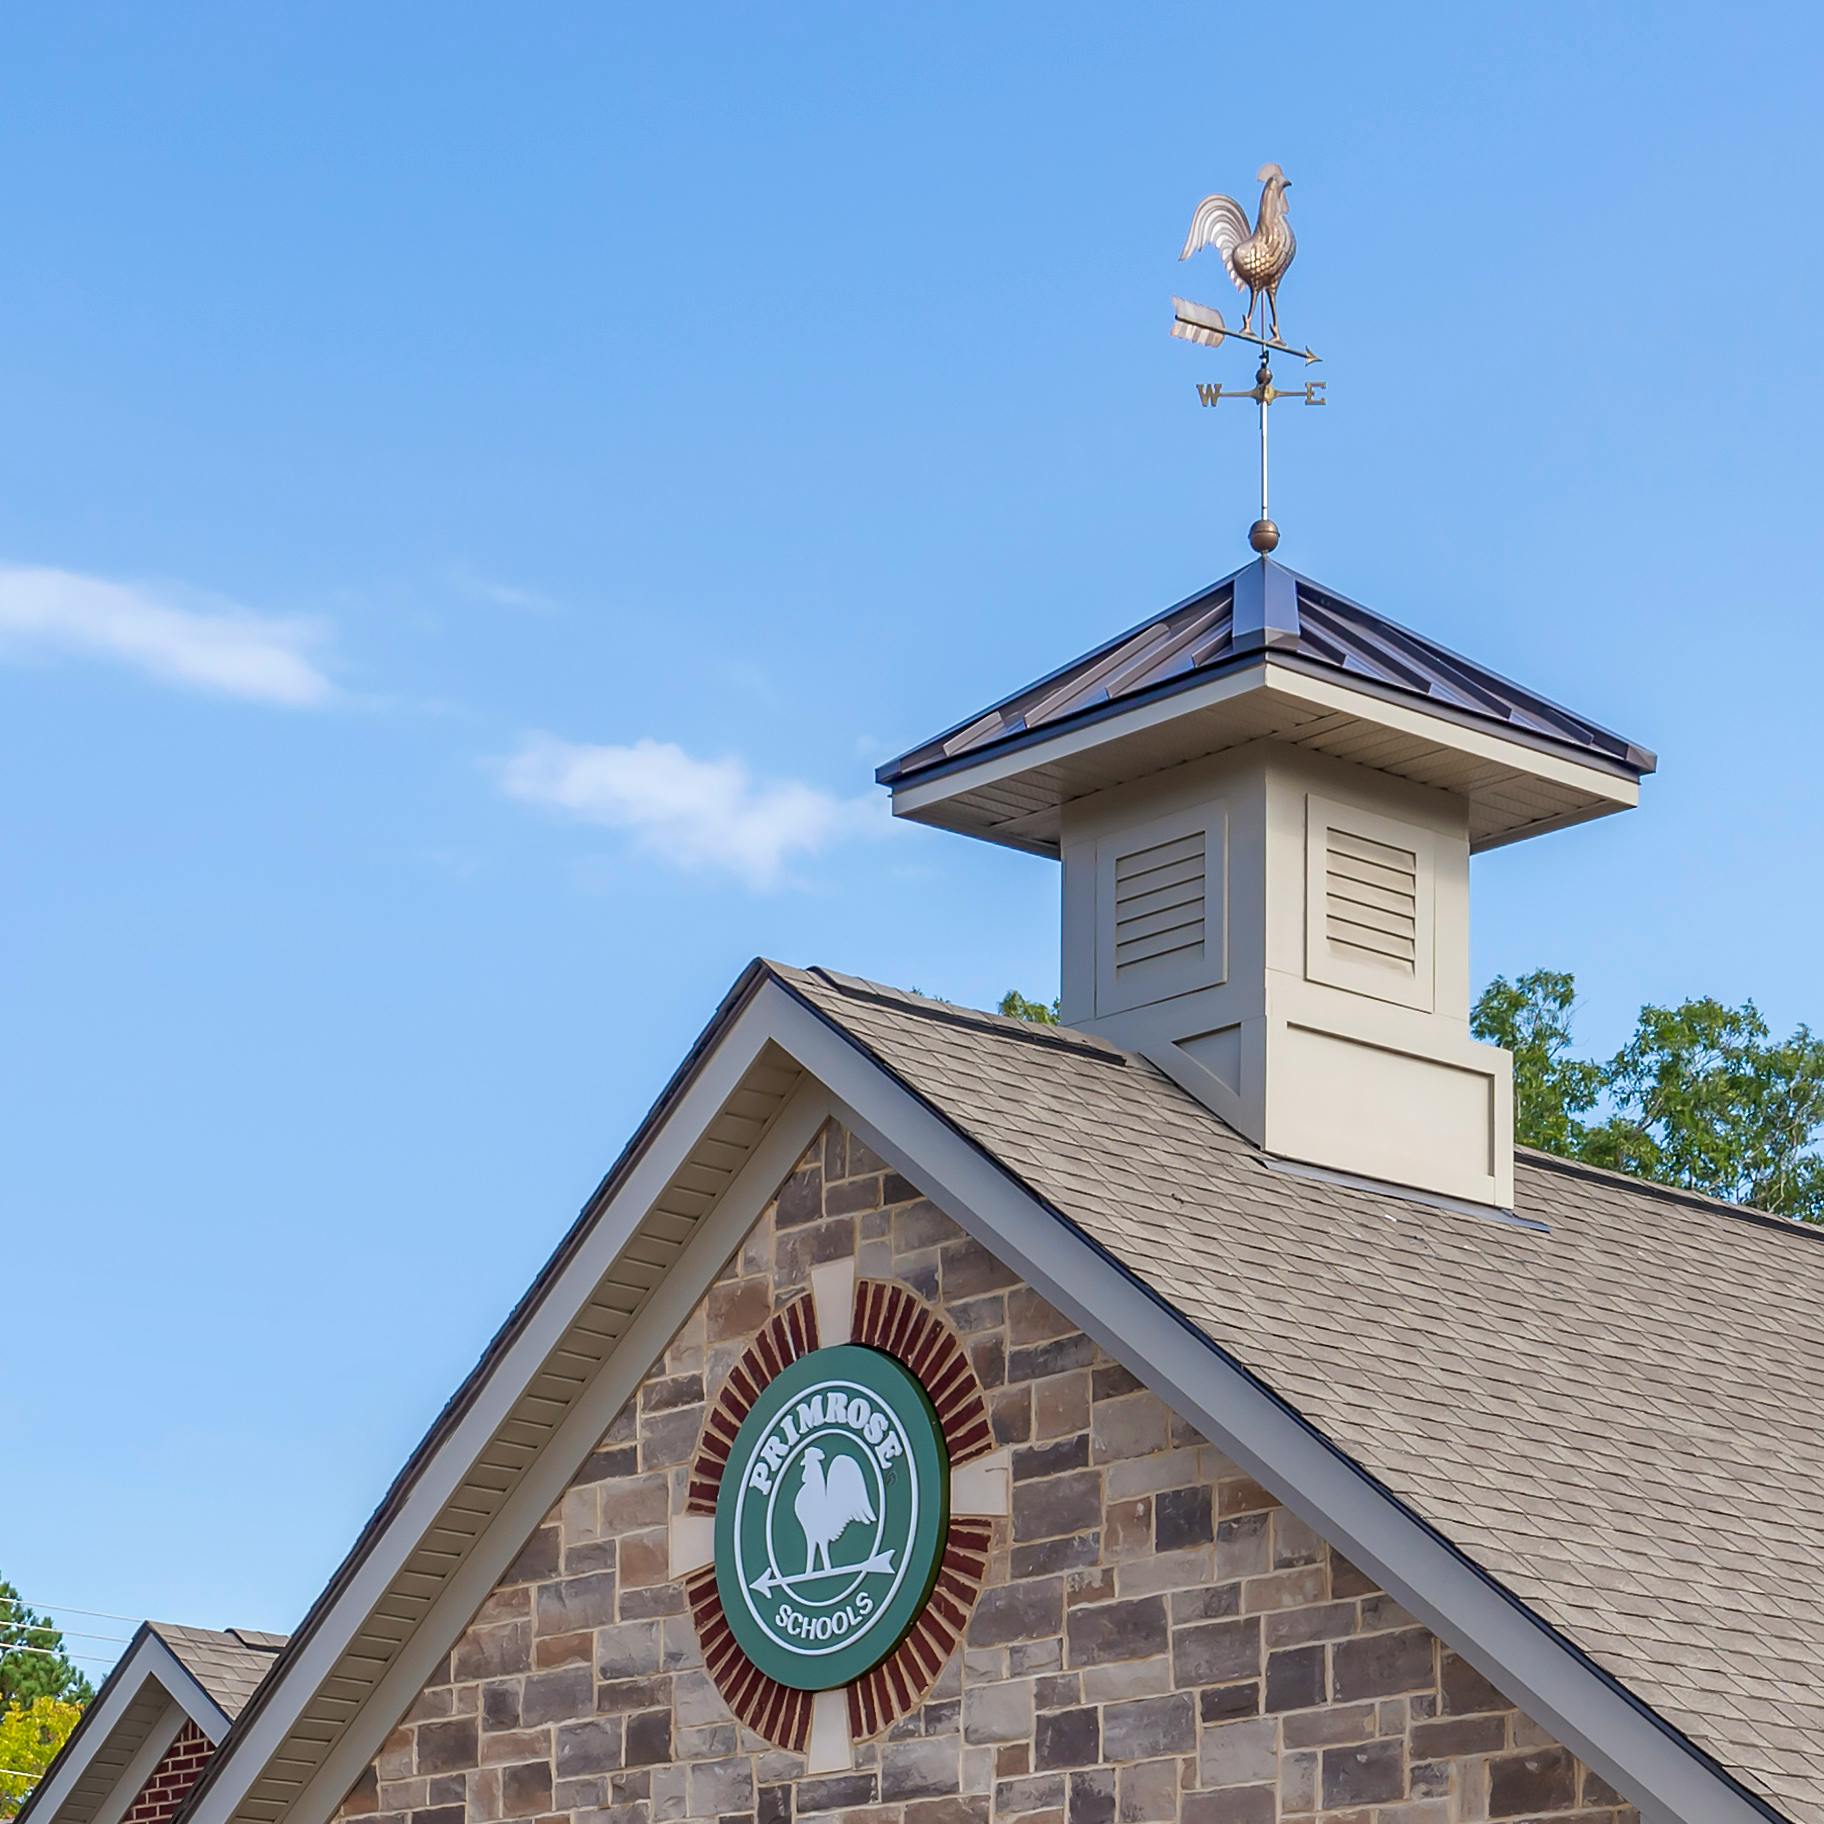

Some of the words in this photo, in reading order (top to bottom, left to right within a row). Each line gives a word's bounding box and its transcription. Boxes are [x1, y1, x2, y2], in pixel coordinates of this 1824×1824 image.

[1196, 383, 1222, 407] W
[1305, 382, 1327, 405] E
[749, 1392, 904, 1496] PRIMROSE
[775, 1591, 874, 1640] SCHOOLS
